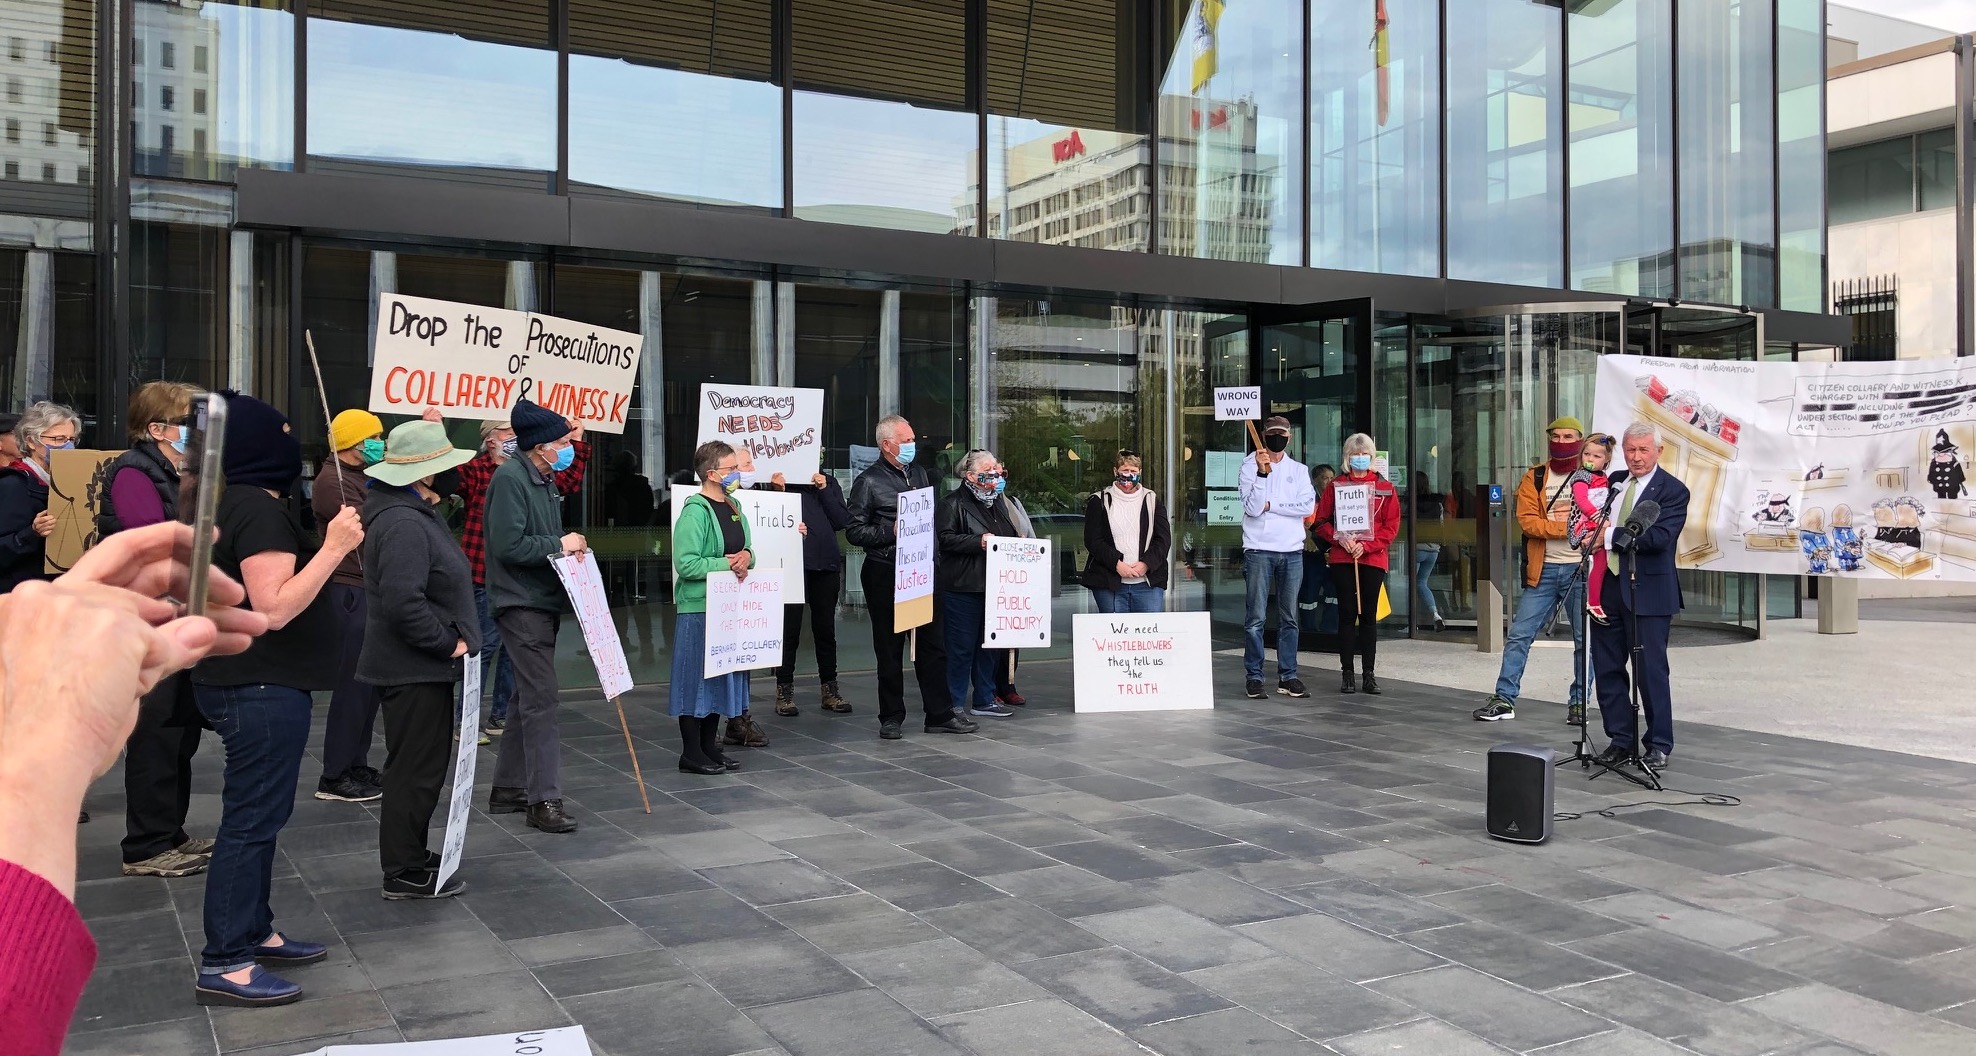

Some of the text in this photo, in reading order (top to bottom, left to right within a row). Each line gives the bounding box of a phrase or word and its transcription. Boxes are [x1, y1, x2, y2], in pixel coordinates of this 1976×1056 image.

[389, 301, 634, 369] Drop the Prosecutions
[509, 354, 529, 374] OF
[1680, 363, 1699, 371] FROM
[1702, 362, 1755, 374] INFORMATION
[1808, 383, 1844, 392] CITIZEN
[1847, 382, 1888, 392] COLLAERY
[1890, 382, 1909, 391] AND
[1913, 380, 1953, 390] WITNESS
[384, 366, 628, 423] COLLAERY & WITNESS K
[1217, 390, 1258, 401] WRONG
[1810, 393, 1879, 401] CHARGED WITH
[707, 390, 795, 420] Democracy
[1226, 407, 1250, 416] WAY
[1857, 403, 1904, 411] INCLUDING
[1797, 411, 1915, 422] UNDER SECTION OF THE
[1871, 422, 1892, 430] HOW
[1911, 416, 1926, 424] YOU
[1929, 409, 1960, 421] PLEAD
[717, 414, 784, 435] NEEDS
[1337, 489, 1364, 500] Truth
[899, 492, 932, 517] Drop the
[754, 501, 795, 529] trials
[1219, 514, 1234, 522] Entry
[1341, 514, 1364, 525] Free
[1000, 543, 1018, 552] CLOSE
[1024, 543, 1038, 552] REAL
[897, 544, 928, 566] This is not
[999, 569, 1028, 583] HOLD
[713, 580, 779, 594] SECRET TRIALS
[999, 585, 1006, 594] A
[742, 600, 763, 611] HIDE
[997, 595, 1032, 610] PUBLIC
[736, 617, 768, 630] TRUTH
[996, 615, 1043, 631] INQUIRY
[1111, 622, 1159, 634] We need
[711, 639, 782, 656] BERNARD COLLAERY
[717, 659, 722, 669] IS
[736, 654, 757, 664] HERO
[1108, 655, 1130, 673] they
[1133, 656, 1150, 667] tell
[1128, 669, 1142, 679] the
[1118, 683, 1159, 695] TRUTH
